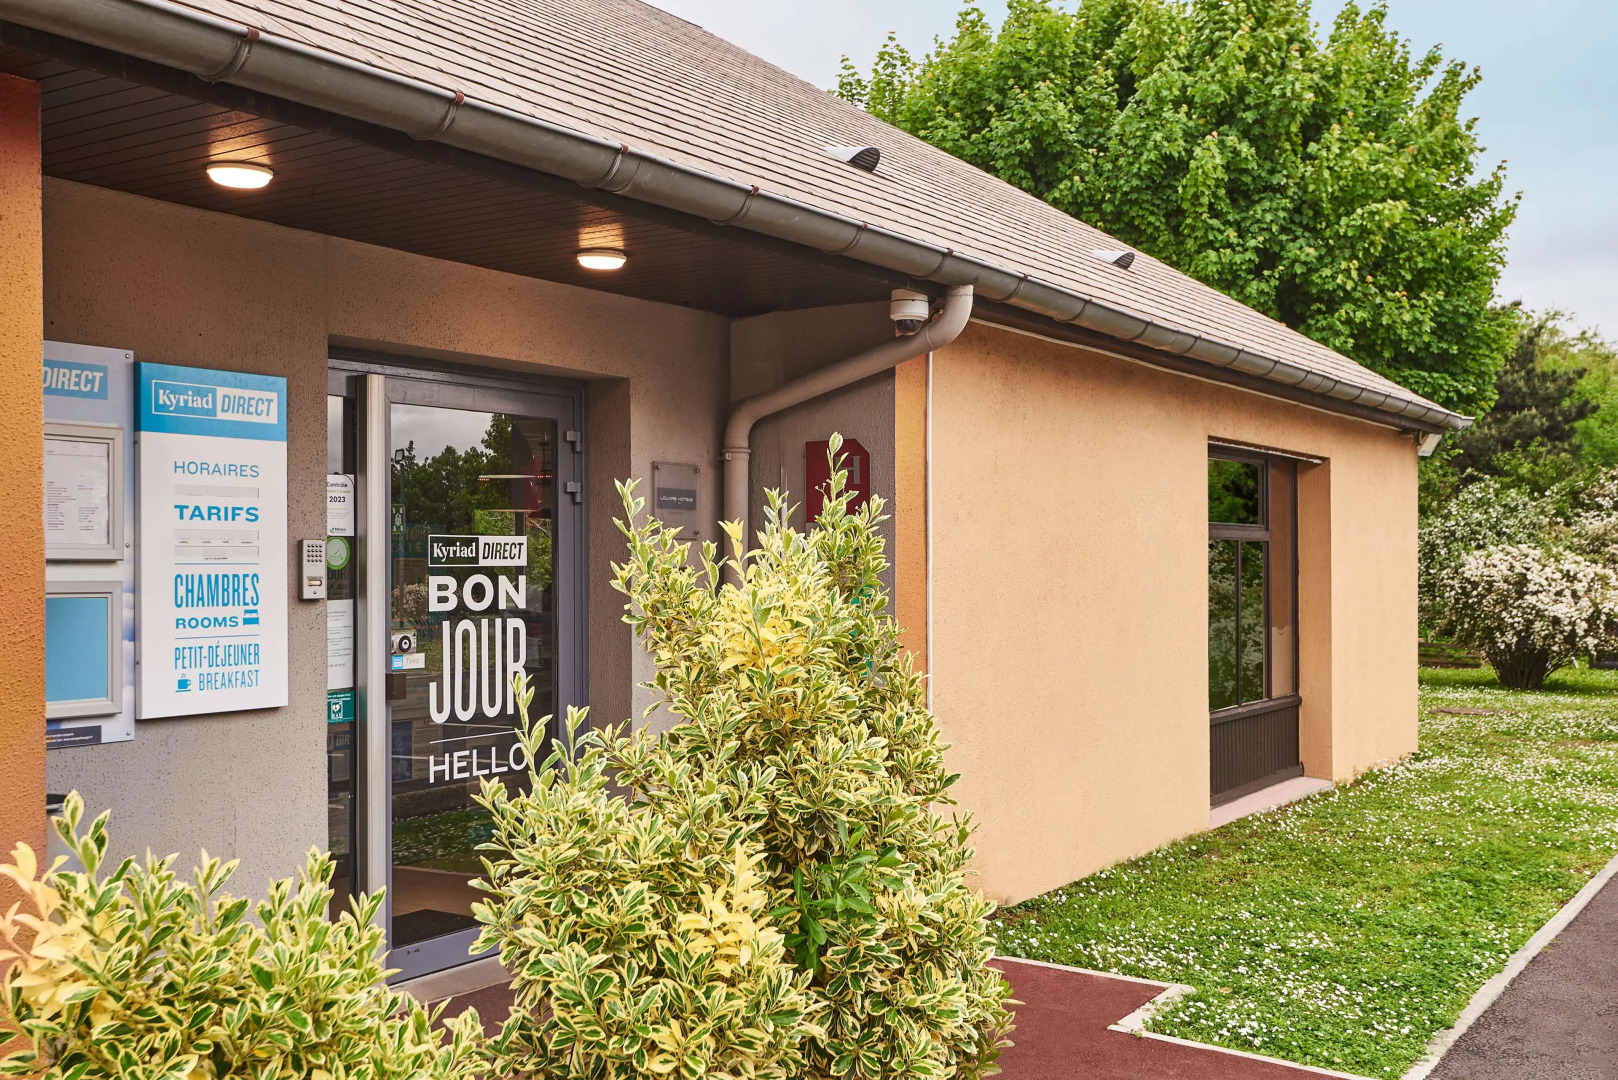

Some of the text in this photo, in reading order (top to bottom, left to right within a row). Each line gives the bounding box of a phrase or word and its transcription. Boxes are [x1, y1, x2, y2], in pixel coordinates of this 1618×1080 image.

[43, 366, 104, 393] DIRECT
[158, 388, 274, 417] Kyriad DIRECT
[174, 460, 259, 478] HORAIRES
[174, 504, 259, 522] TARIFS
[433, 541, 524, 565] Kyriad DIRECT
[174, 572, 259, 609] CHAMBRES
[428, 573, 527, 612] BON
[175, 616, 239, 629] ROOMS
[174, 640, 260, 669] PETIT-DÉJEUNER
[199, 670, 259, 691] BREAKFAST
[429, 617, 527, 724] JOUR
[429, 742, 528, 783] HELLO
